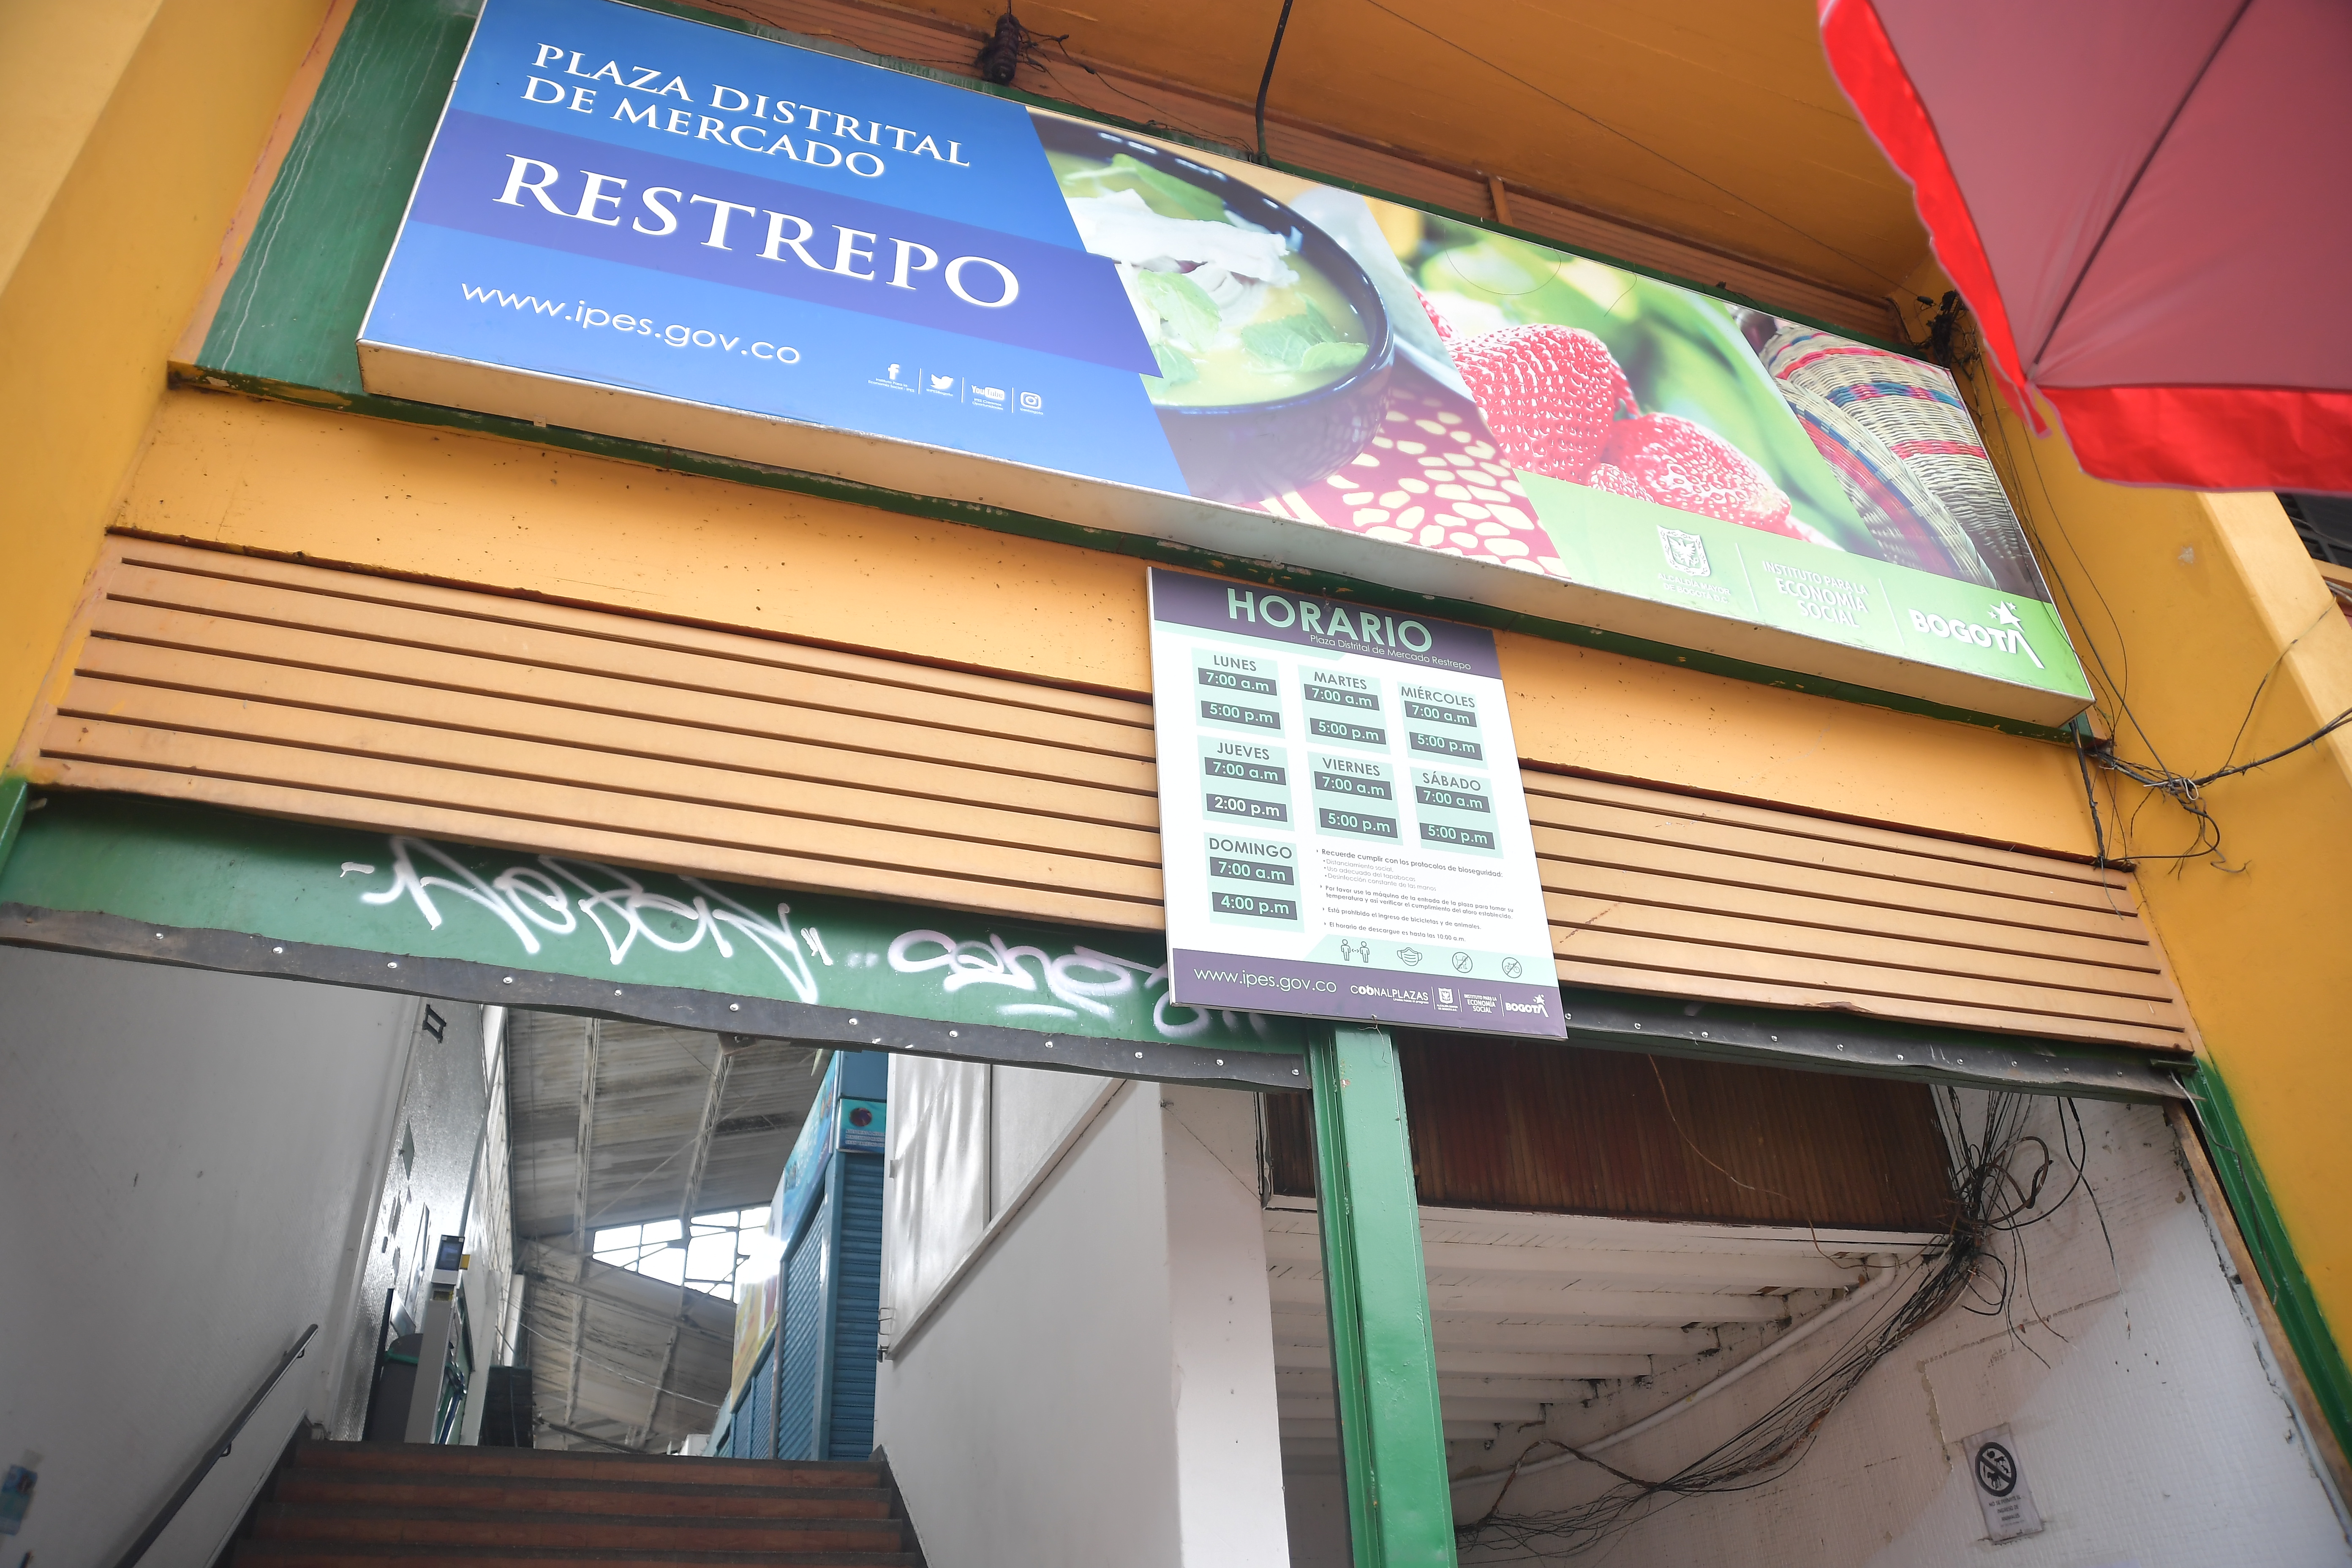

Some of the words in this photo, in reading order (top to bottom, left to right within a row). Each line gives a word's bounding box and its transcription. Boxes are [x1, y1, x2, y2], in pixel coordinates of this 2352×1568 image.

[534, 44, 693, 101] PLAZA
[710, 85, 969, 166] DISTRITAL
[522, 76, 596, 113] DE
[611, 98, 884, 176] MERCADO
[493, 155, 1018, 307] RESTREPO
[462, 283, 799, 363] www.ipes.gov.co
[971, 385, 1005, 400] YouTube
[972, 401, 1003, 410] Oportunidades
[1658, 573, 1700, 588] ALCALDÍA
[1700, 583, 1731, 595] MAYOR
[1762, 561, 1822, 584] INSTITUTO
[1824, 575, 1854, 591] PARA
[1853, 583, 1869, 595] LA
[1663, 583, 1676, 591] DE
[1714, 594, 1730, 604] D.C.
[1775, 577, 1869, 612] ECONOMÍA
[1226, 587, 1433, 652] HORARIO
[1797, 600, 1860, 628] SOCIAL
[1310, 634, 1335, 646] Plaza
[1338, 640, 1370, 652] Distrital
[1372, 646, 1385, 655] de
[1388, 649, 1430, 663] Mercado
[1432, 656, 1471, 670] Restrepo
[1214, 655, 1257, 671] LUNES
[1206, 672, 1236, 687] 7:00
[1241, 679, 1269, 692] a.m
[1314, 671, 1367, 690] MARTES
[1312, 687, 1341, 702] 7:00
[1345, 694, 1372, 707] a.m
[1401, 686, 1475, 708] MIÉRCOLES
[1209, 703, 1240, 718] 5:00
[1244, 710, 1273, 724] p.m
[1412, 705, 1440, 719] 7:00
[1444, 712, 1470, 724] a.m
[1318, 721, 1348, 736] 5:00
[1352, 728, 1379, 741] p.m
[1217, 742, 1270, 760] JUEVES
[1417, 734, 1445, 749] 5:00
[1449, 740, 1475, 753] p.m
[1213, 762, 1244, 776] 7:00
[1249, 768, 1279, 781] a.m
[1322, 757, 1380, 776] VIERNES
[1322, 776, 1352, 791] 7:00
[1356, 783, 1385, 796] a.m
[1423, 771, 1481, 791] SÁBADO
[1214, 796, 1246, 812] 2:00
[1251, 803, 1280, 817] p.m
[1423, 790, 1452, 805] 7:00
[1456, 797, 1483, 809] a.m
[1328, 813, 1358, 828] 5:00
[1362, 820, 1390, 833] p.m
[1428, 825, 1456, 839] 5:00
[1461, 832, 1487, 844] p.m
[1209, 838, 1292, 859] DOMINGO
[1218, 861, 1251, 877] 7:00
[1255, 868, 1286, 881] a.m
[1322, 849, 1355, 858] Recuerde
[1358, 854, 1383, 862] cumplir
[1411, 861, 1446, 870] protocolos
[1458, 866, 1503, 877] bioseguridad:
[1326, 859, 1373, 870] Distanciamiento
[1328, 874, 1366, 882] Desinfección
[1339, 868, 1371, 876] adecuado
[1384, 873, 1415, 881] tapabocas
[1373, 891, 1399, 899] máquina
[1221, 896, 1254, 910] 4:00
[1259, 901, 1289, 915] p.m
[1326, 893, 1363, 901] temperatura
[1412, 904, 1450, 912] cumplimiento
[1479, 911, 1513, 919] establecido.
[1193, 969, 1337, 993] www.ipes.gov.co
[1467, 999, 1496, 1007] ECONOMÍA
